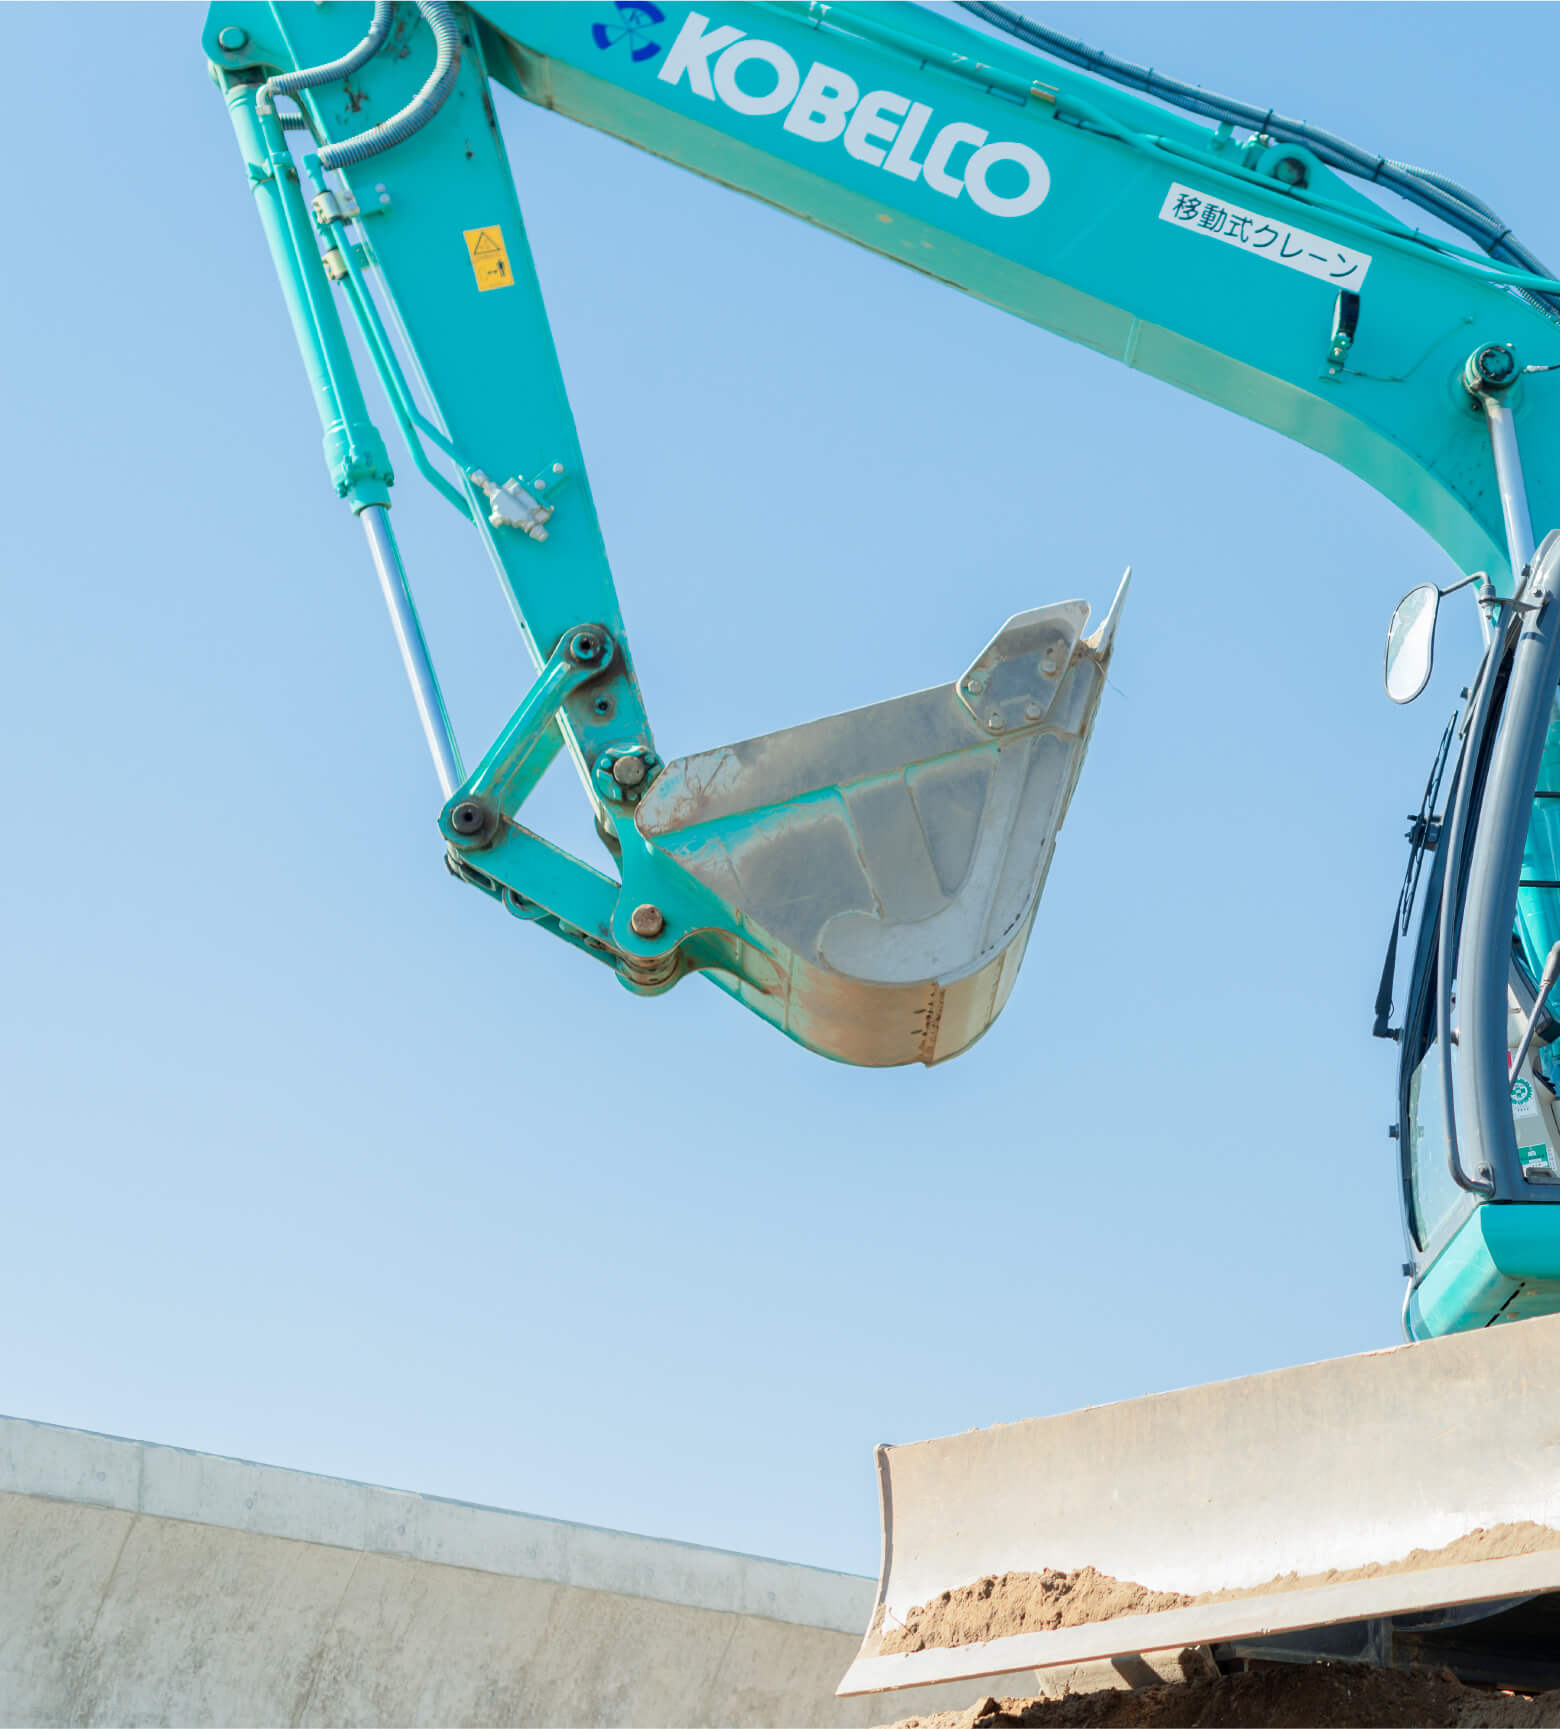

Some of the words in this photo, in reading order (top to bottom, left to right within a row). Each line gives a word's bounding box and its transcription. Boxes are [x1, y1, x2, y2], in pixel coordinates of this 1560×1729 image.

[657, 11, 1051, 218] KOBELCO
[1172, 193, 1359, 278] 移動式クレーン
